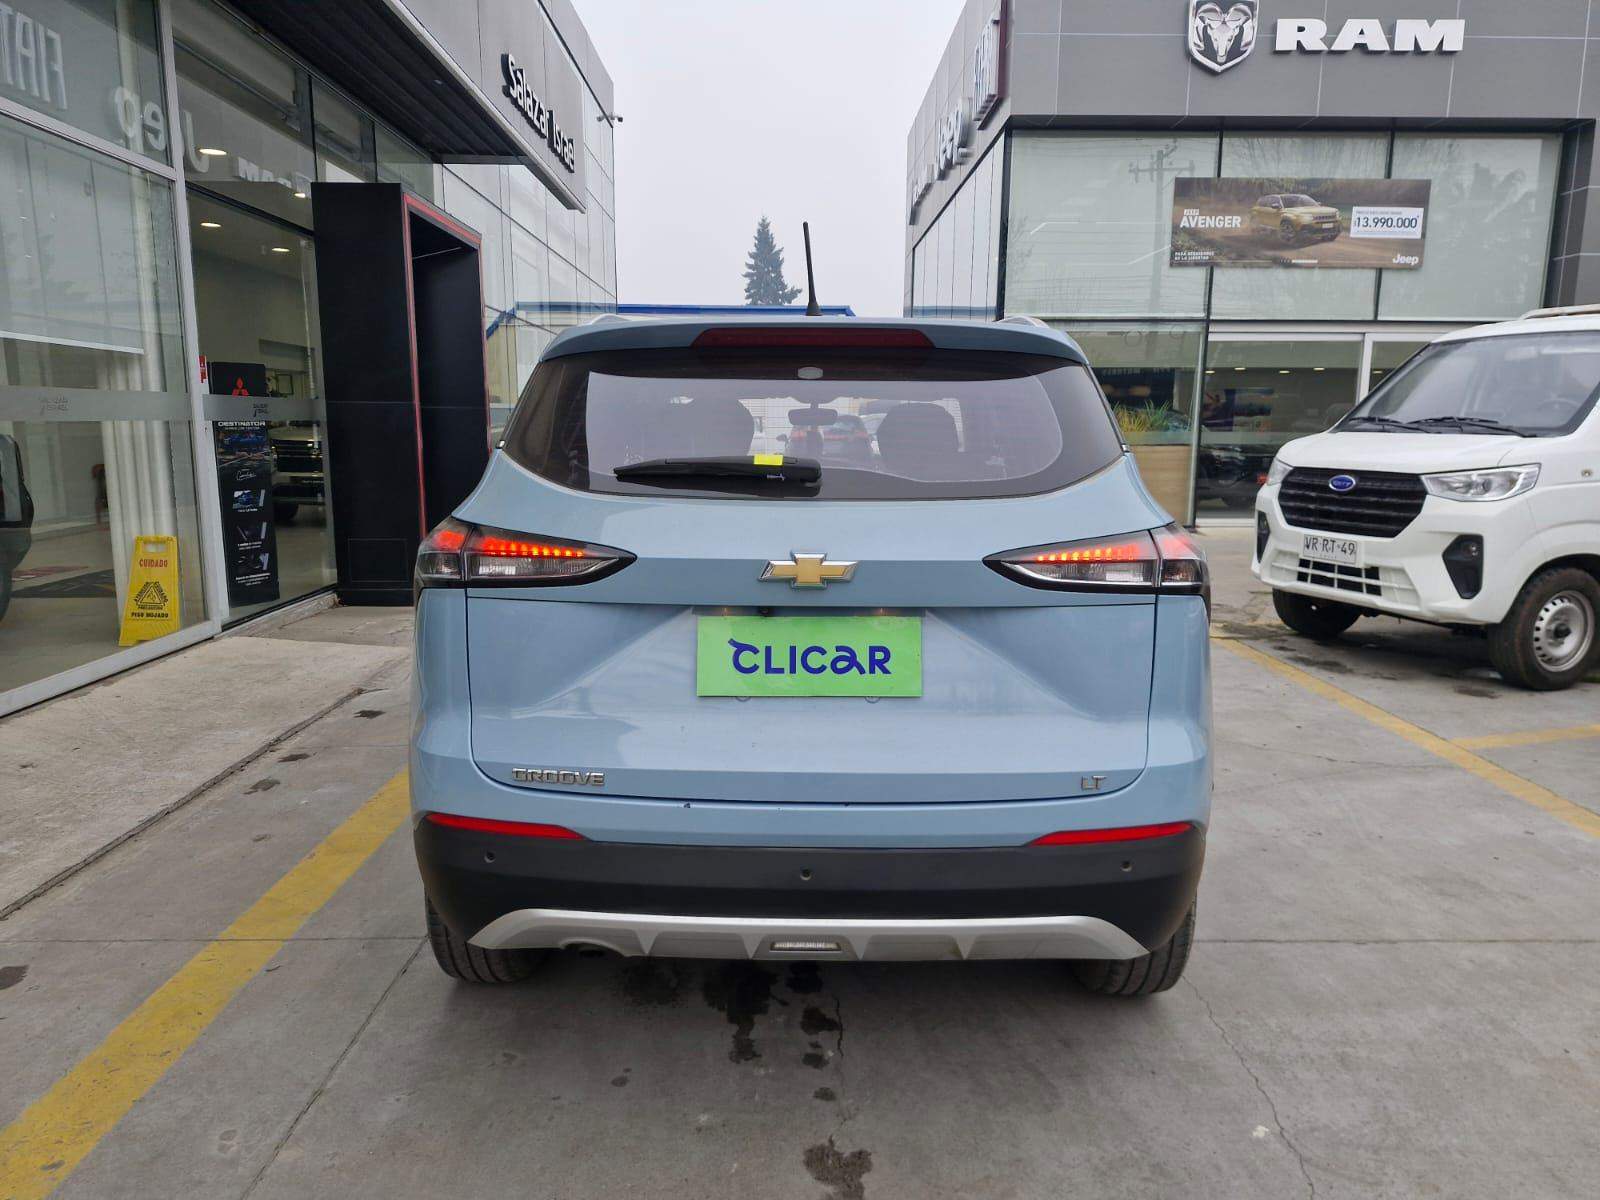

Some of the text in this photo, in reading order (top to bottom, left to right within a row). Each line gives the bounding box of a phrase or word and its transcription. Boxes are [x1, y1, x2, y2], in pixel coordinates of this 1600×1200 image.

[1275, 19, 1465, 51] RAM
[500, 53, 552, 141] Salazar
[1180, 215, 1242, 228] AVENGER
[1392, 253, 1419, 266] Jeep
[139, 559, 168, 568] CUIDADO
[512, 767, 605, 786] GROOVE
[1081, 775, 1106, 790] LT
